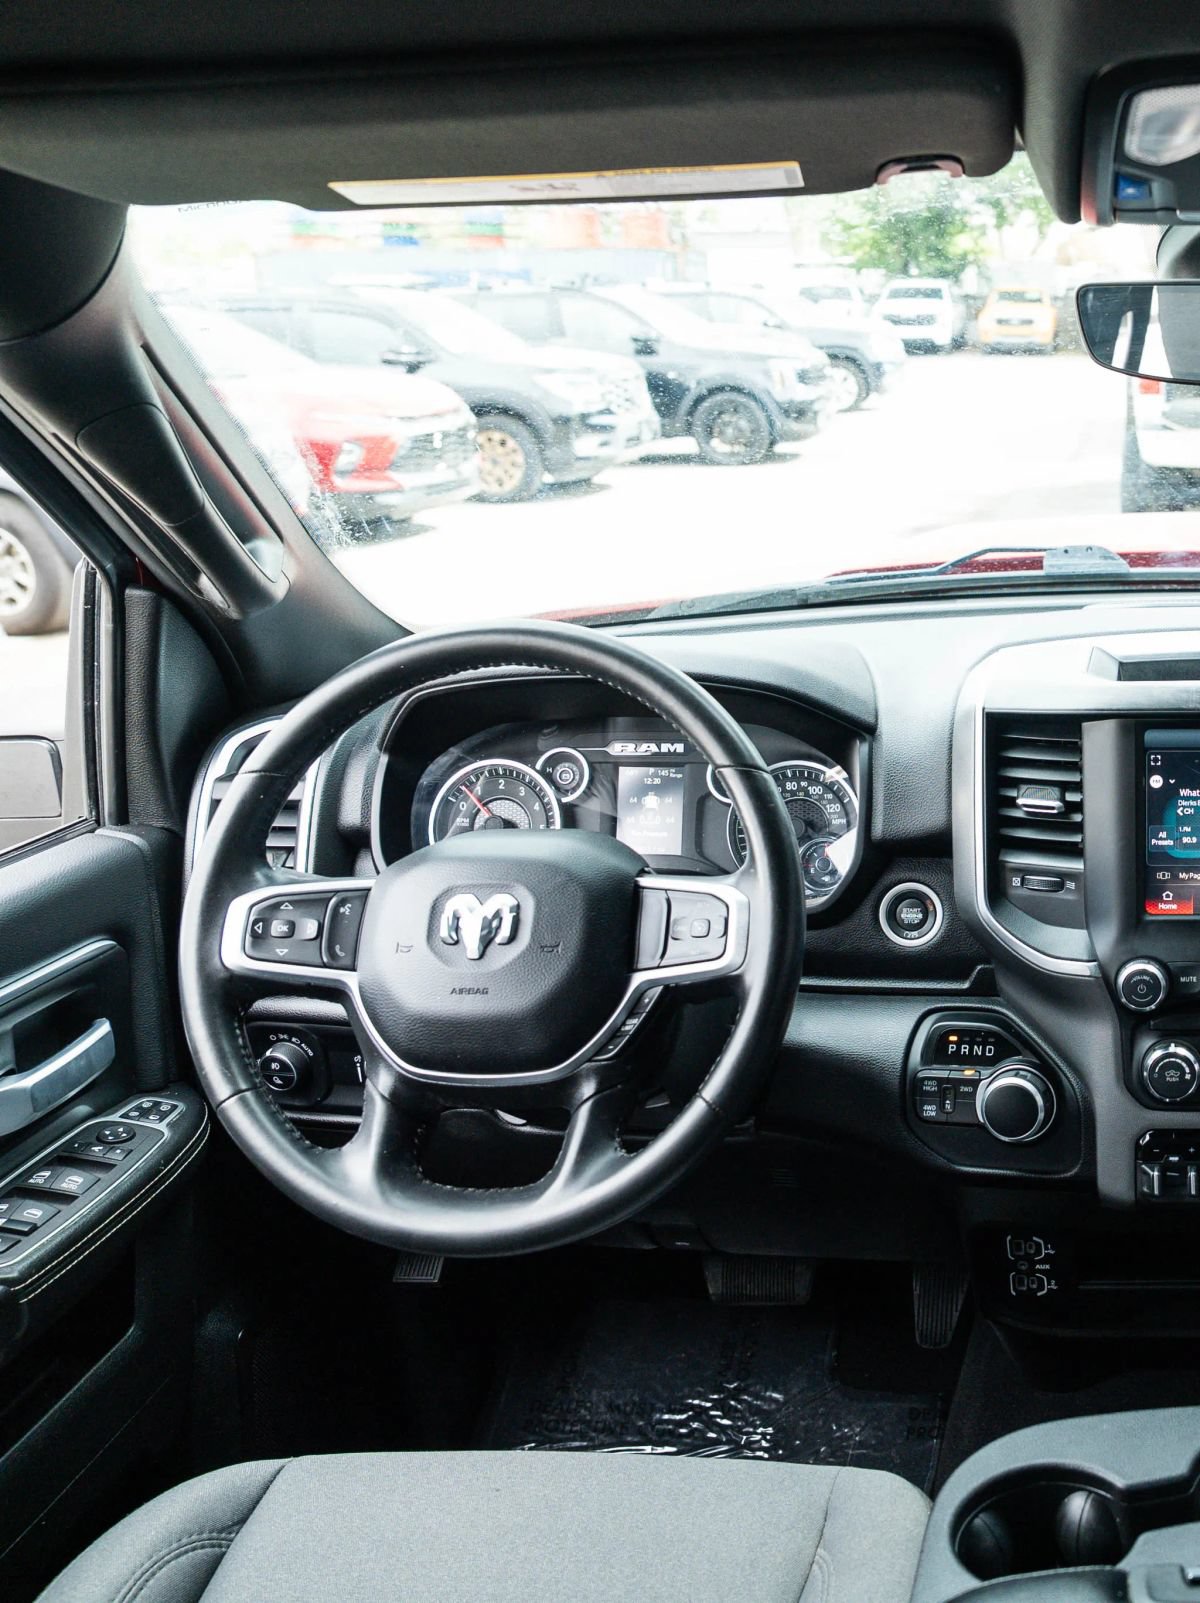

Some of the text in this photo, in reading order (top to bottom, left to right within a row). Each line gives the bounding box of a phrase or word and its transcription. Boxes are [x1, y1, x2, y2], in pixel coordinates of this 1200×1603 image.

[613, 743, 684, 753] RAM
[498, 779, 505, 789] 2
[785, 782, 797, 790] 80
[518, 786, 525, 796] 3
[808, 786, 823, 795] 100
[1179, 789, 1200, 797] What
[460, 801, 467, 810] 0
[533, 802, 540, 811] 4
[826, 804, 840, 813] 120
[450, 987, 489, 995] AIRBAG
[301, 1043, 314, 1057] AUTO
[61, 1182, 77, 1190] AUTO
